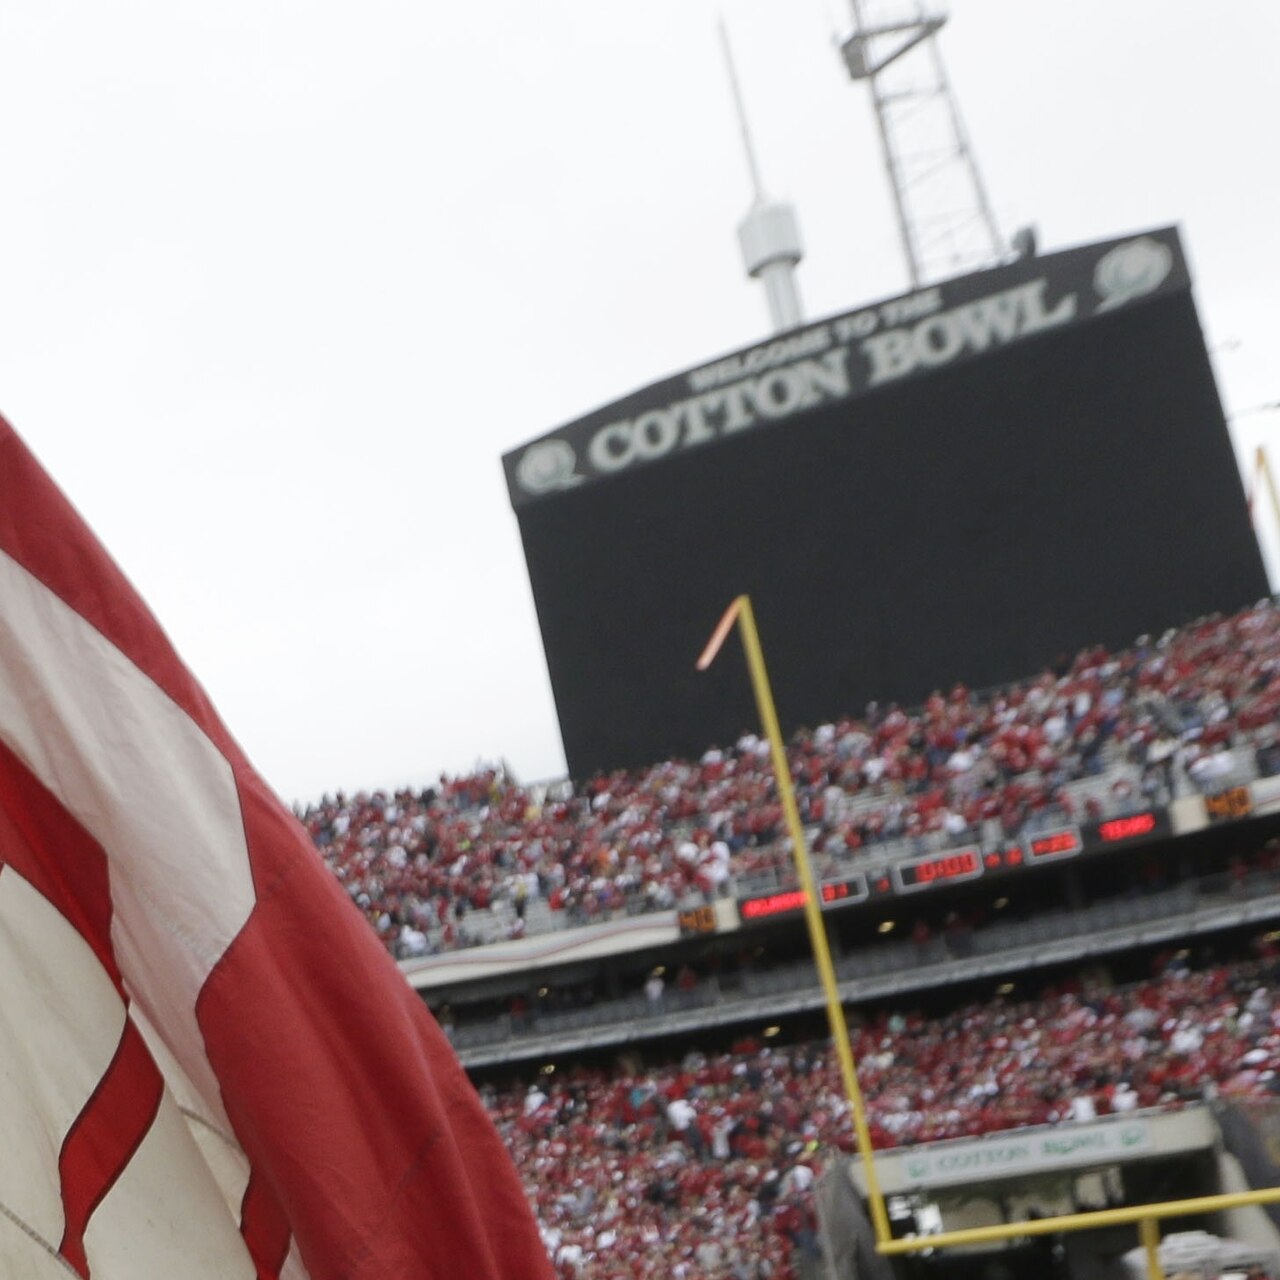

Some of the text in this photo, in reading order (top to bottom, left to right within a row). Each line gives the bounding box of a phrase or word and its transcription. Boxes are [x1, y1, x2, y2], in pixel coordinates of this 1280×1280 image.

[587, 277, 1078, 474] COTTON BOWL
[689, 325, 832, 392] WELCOME
[836, 306, 877, 340] TO
